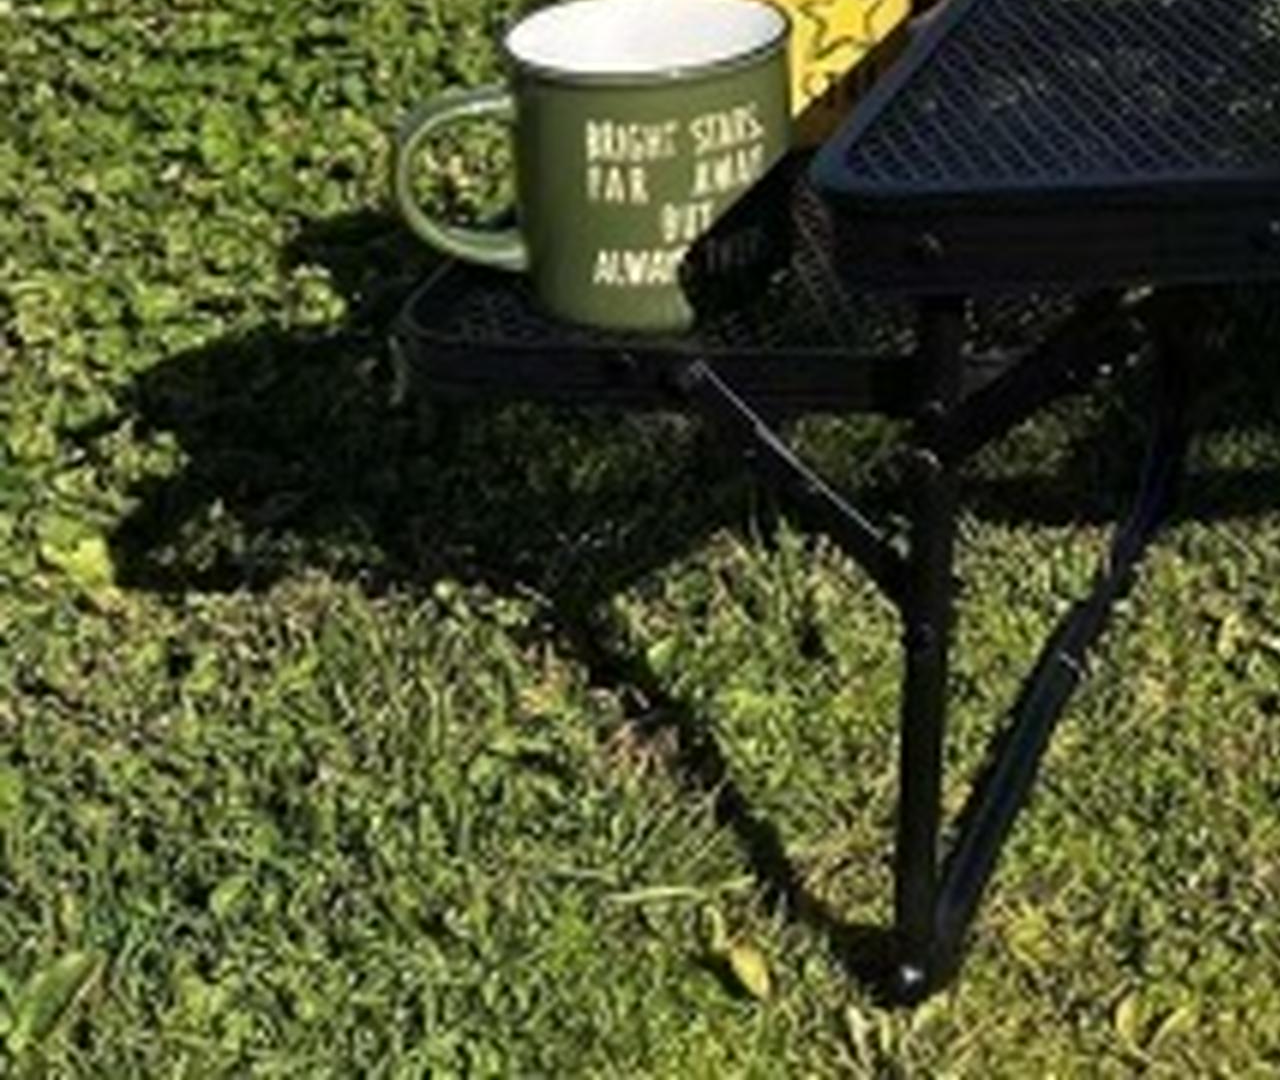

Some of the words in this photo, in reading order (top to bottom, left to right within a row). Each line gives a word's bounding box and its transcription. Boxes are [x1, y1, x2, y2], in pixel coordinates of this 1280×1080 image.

[688, 102, 766, 156] STARS
[586, 164, 650, 205] FAR
[592, 242, 692, 288] ALWAY
